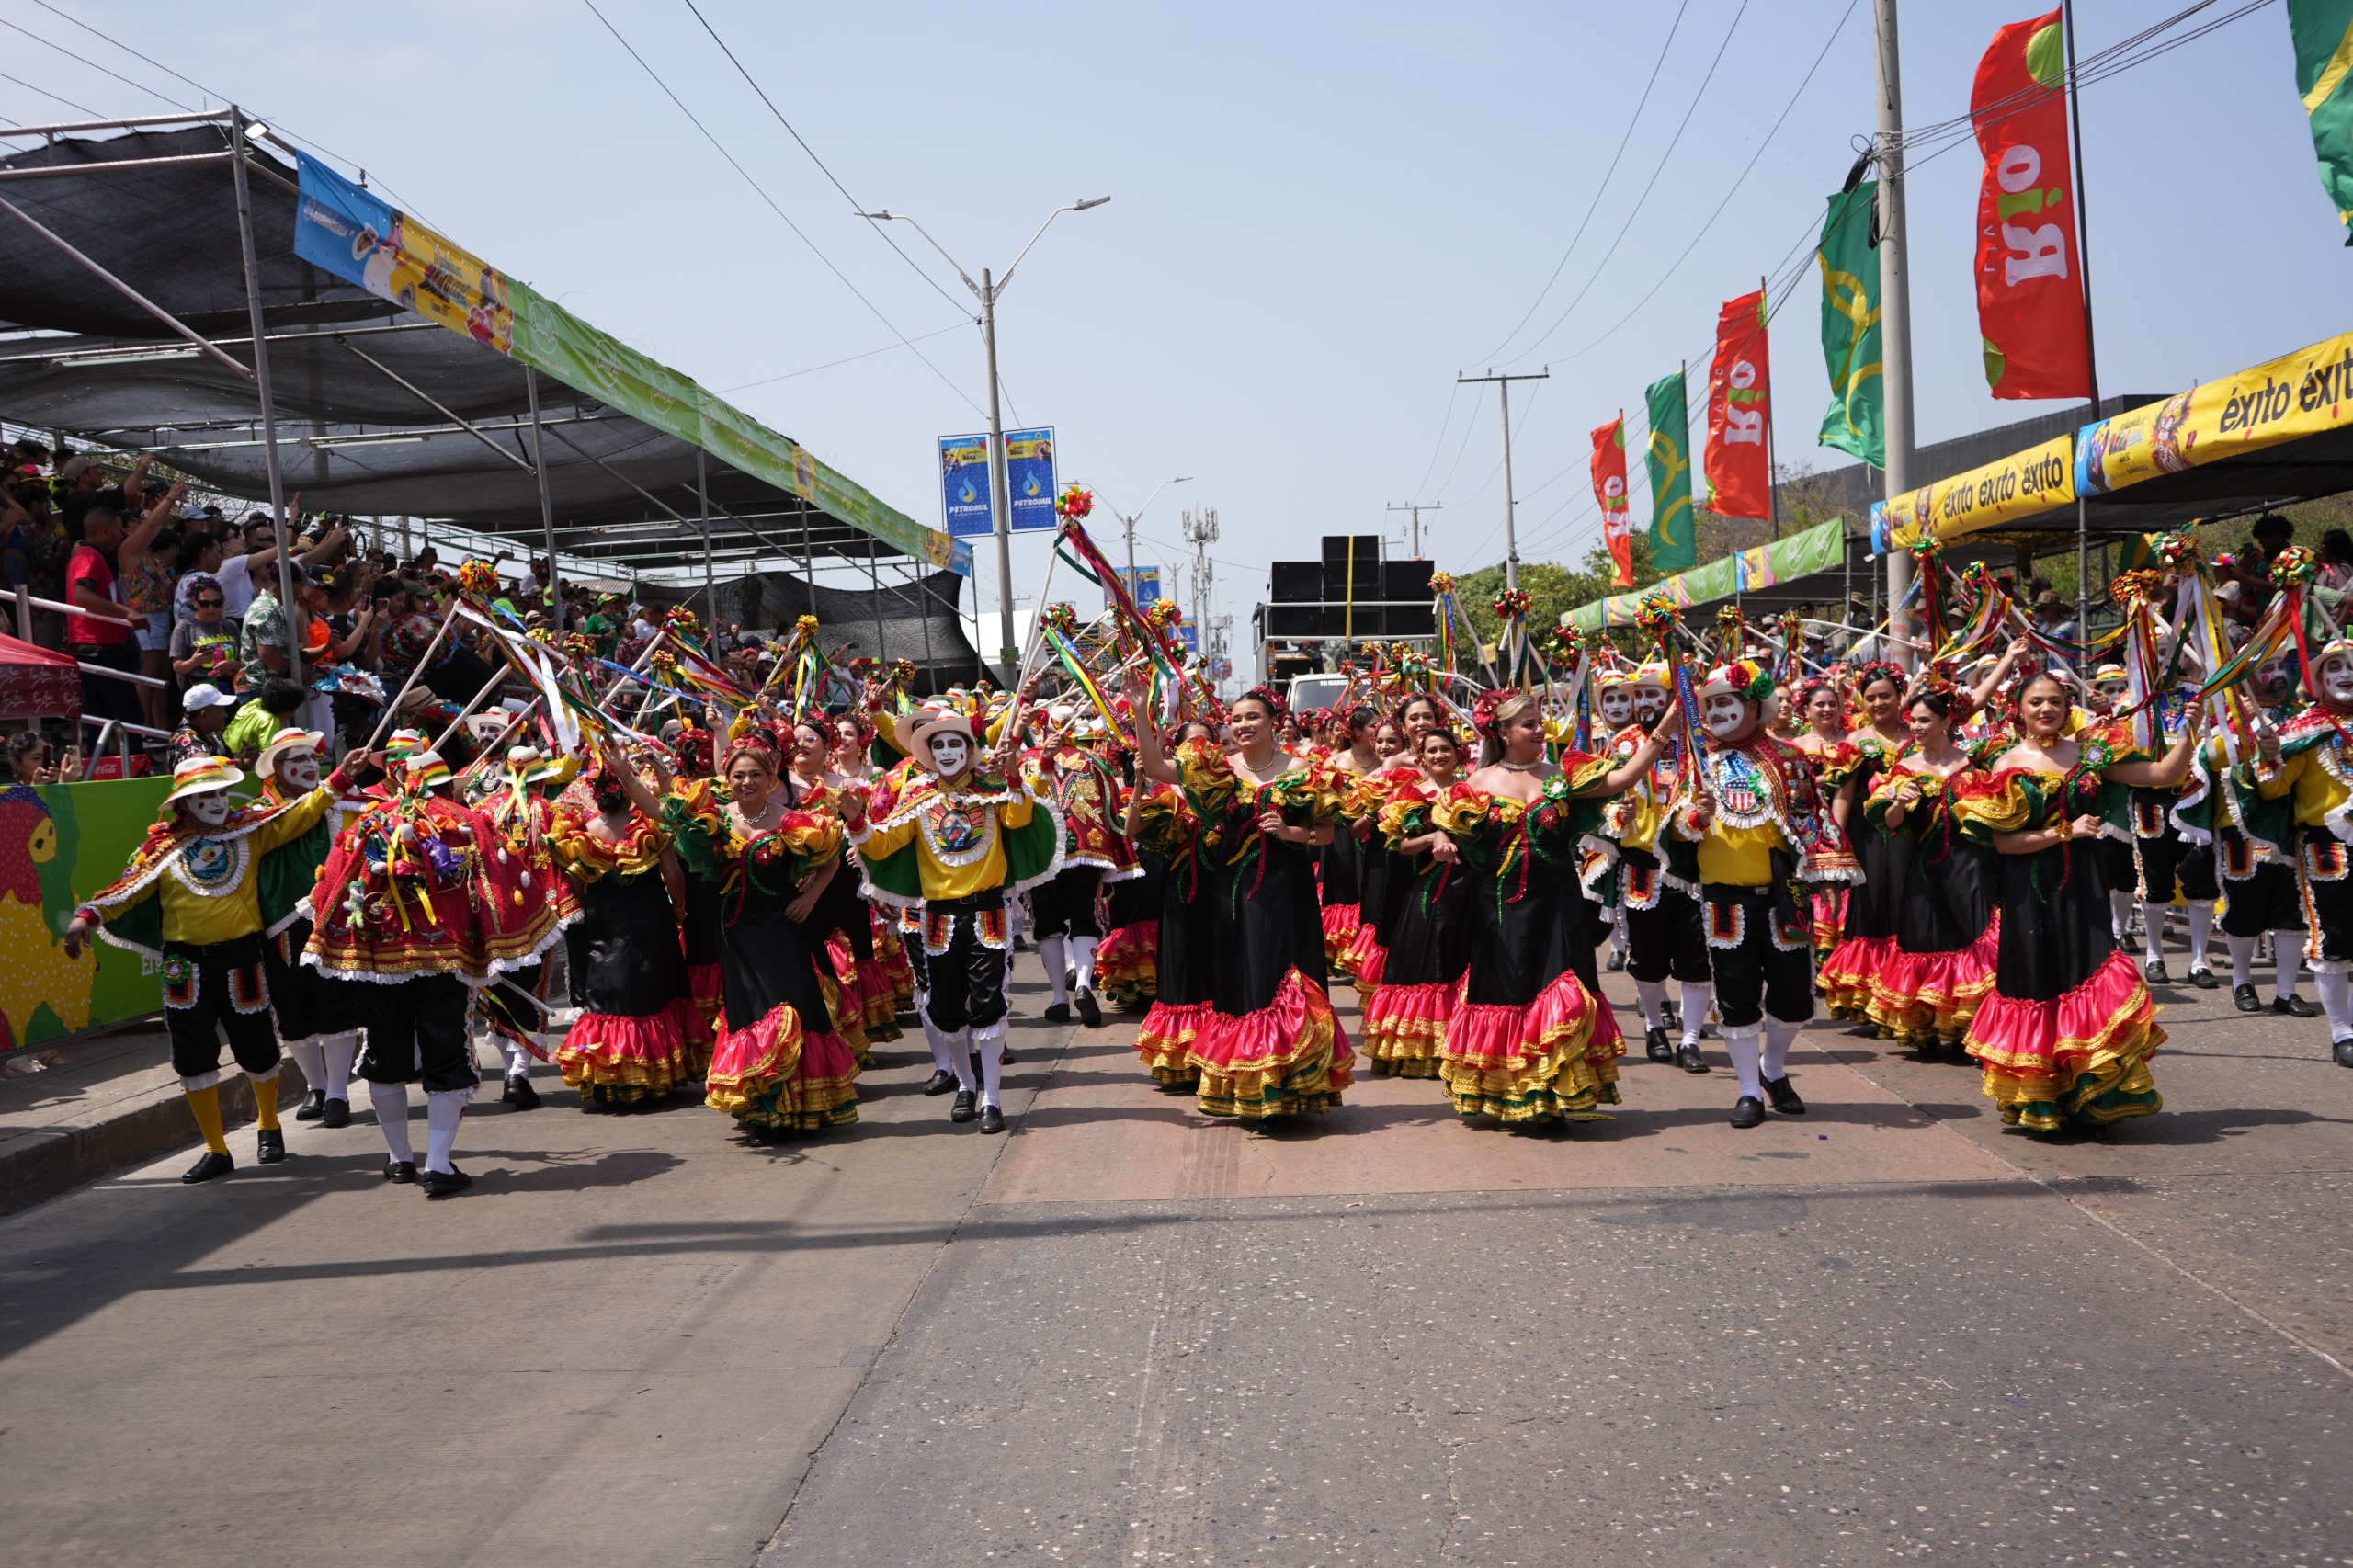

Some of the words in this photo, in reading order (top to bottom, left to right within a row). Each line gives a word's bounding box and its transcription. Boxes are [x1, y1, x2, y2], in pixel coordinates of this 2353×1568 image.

[2220, 377, 2291, 435] éxito
[2300, 347, 2353, 413] éxit
[1944, 480, 1973, 519] éxito
[1979, 467, 2016, 507] éxito
[2022, 452, 2063, 495] éxito
[949, 504, 988, 514] PETROMIL
[1014, 497, 1052, 506] PETROMIL
[1680, 672, 1694, 703] Garabato
[1677, 706, 1686, 733] Garabato
[1688, 704, 1699, 727] Cipote
